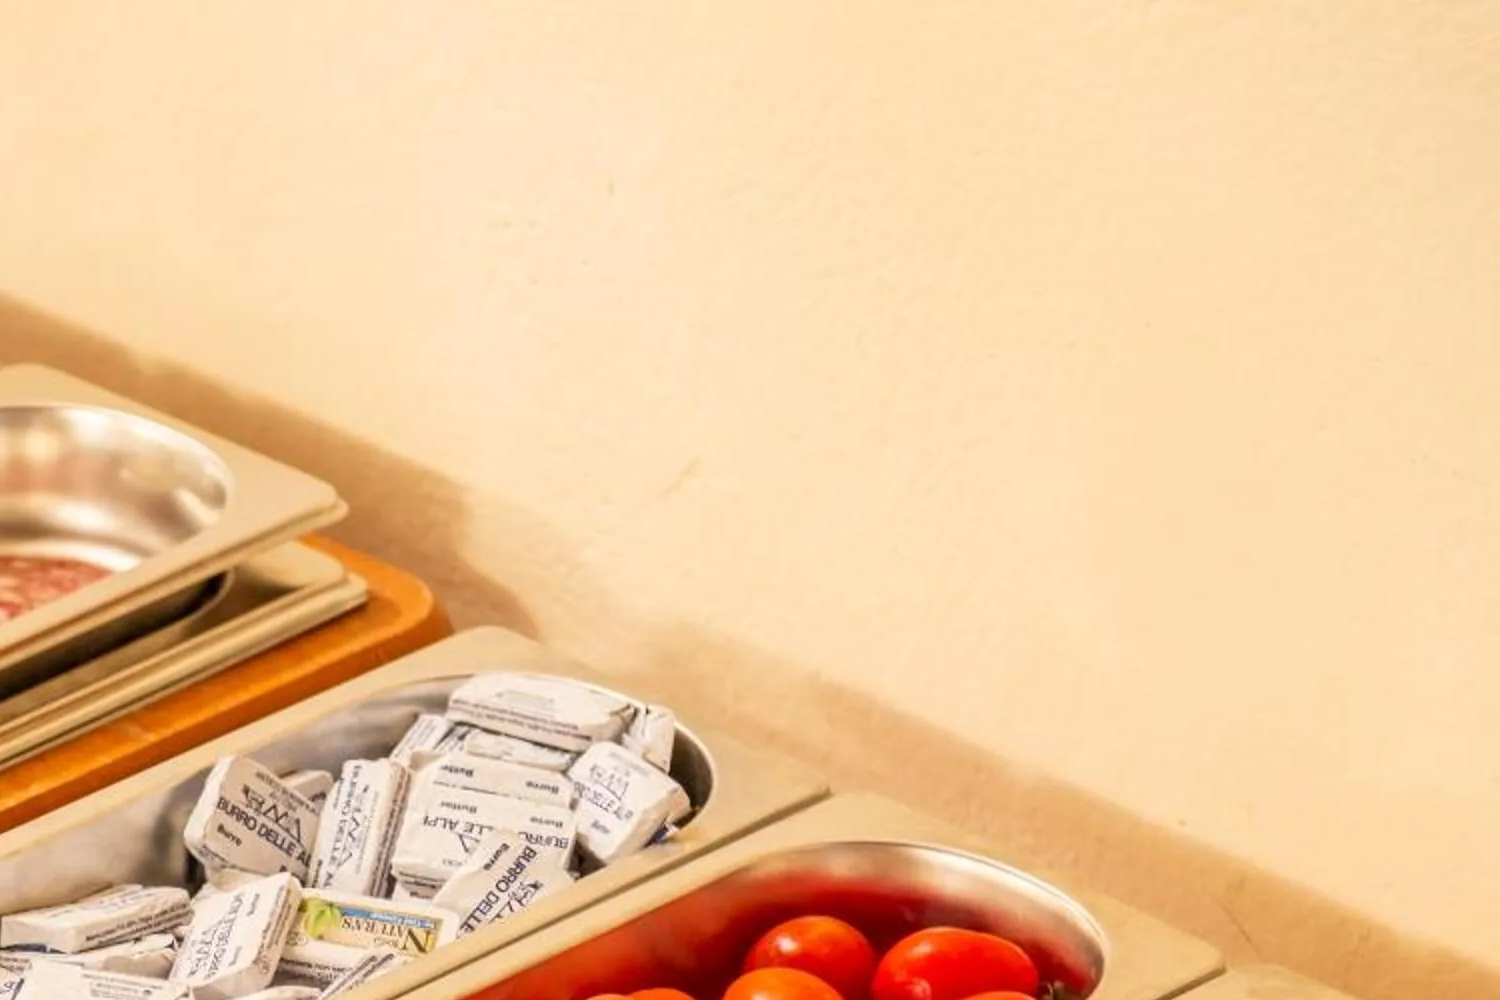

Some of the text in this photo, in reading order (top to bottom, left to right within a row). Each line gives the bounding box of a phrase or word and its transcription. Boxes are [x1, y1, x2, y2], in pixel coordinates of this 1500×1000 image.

[215, 795, 259, 832] BURRO
[256, 821, 298, 857] DELLE
[459, 844, 539, 933] BURRO DELLE
